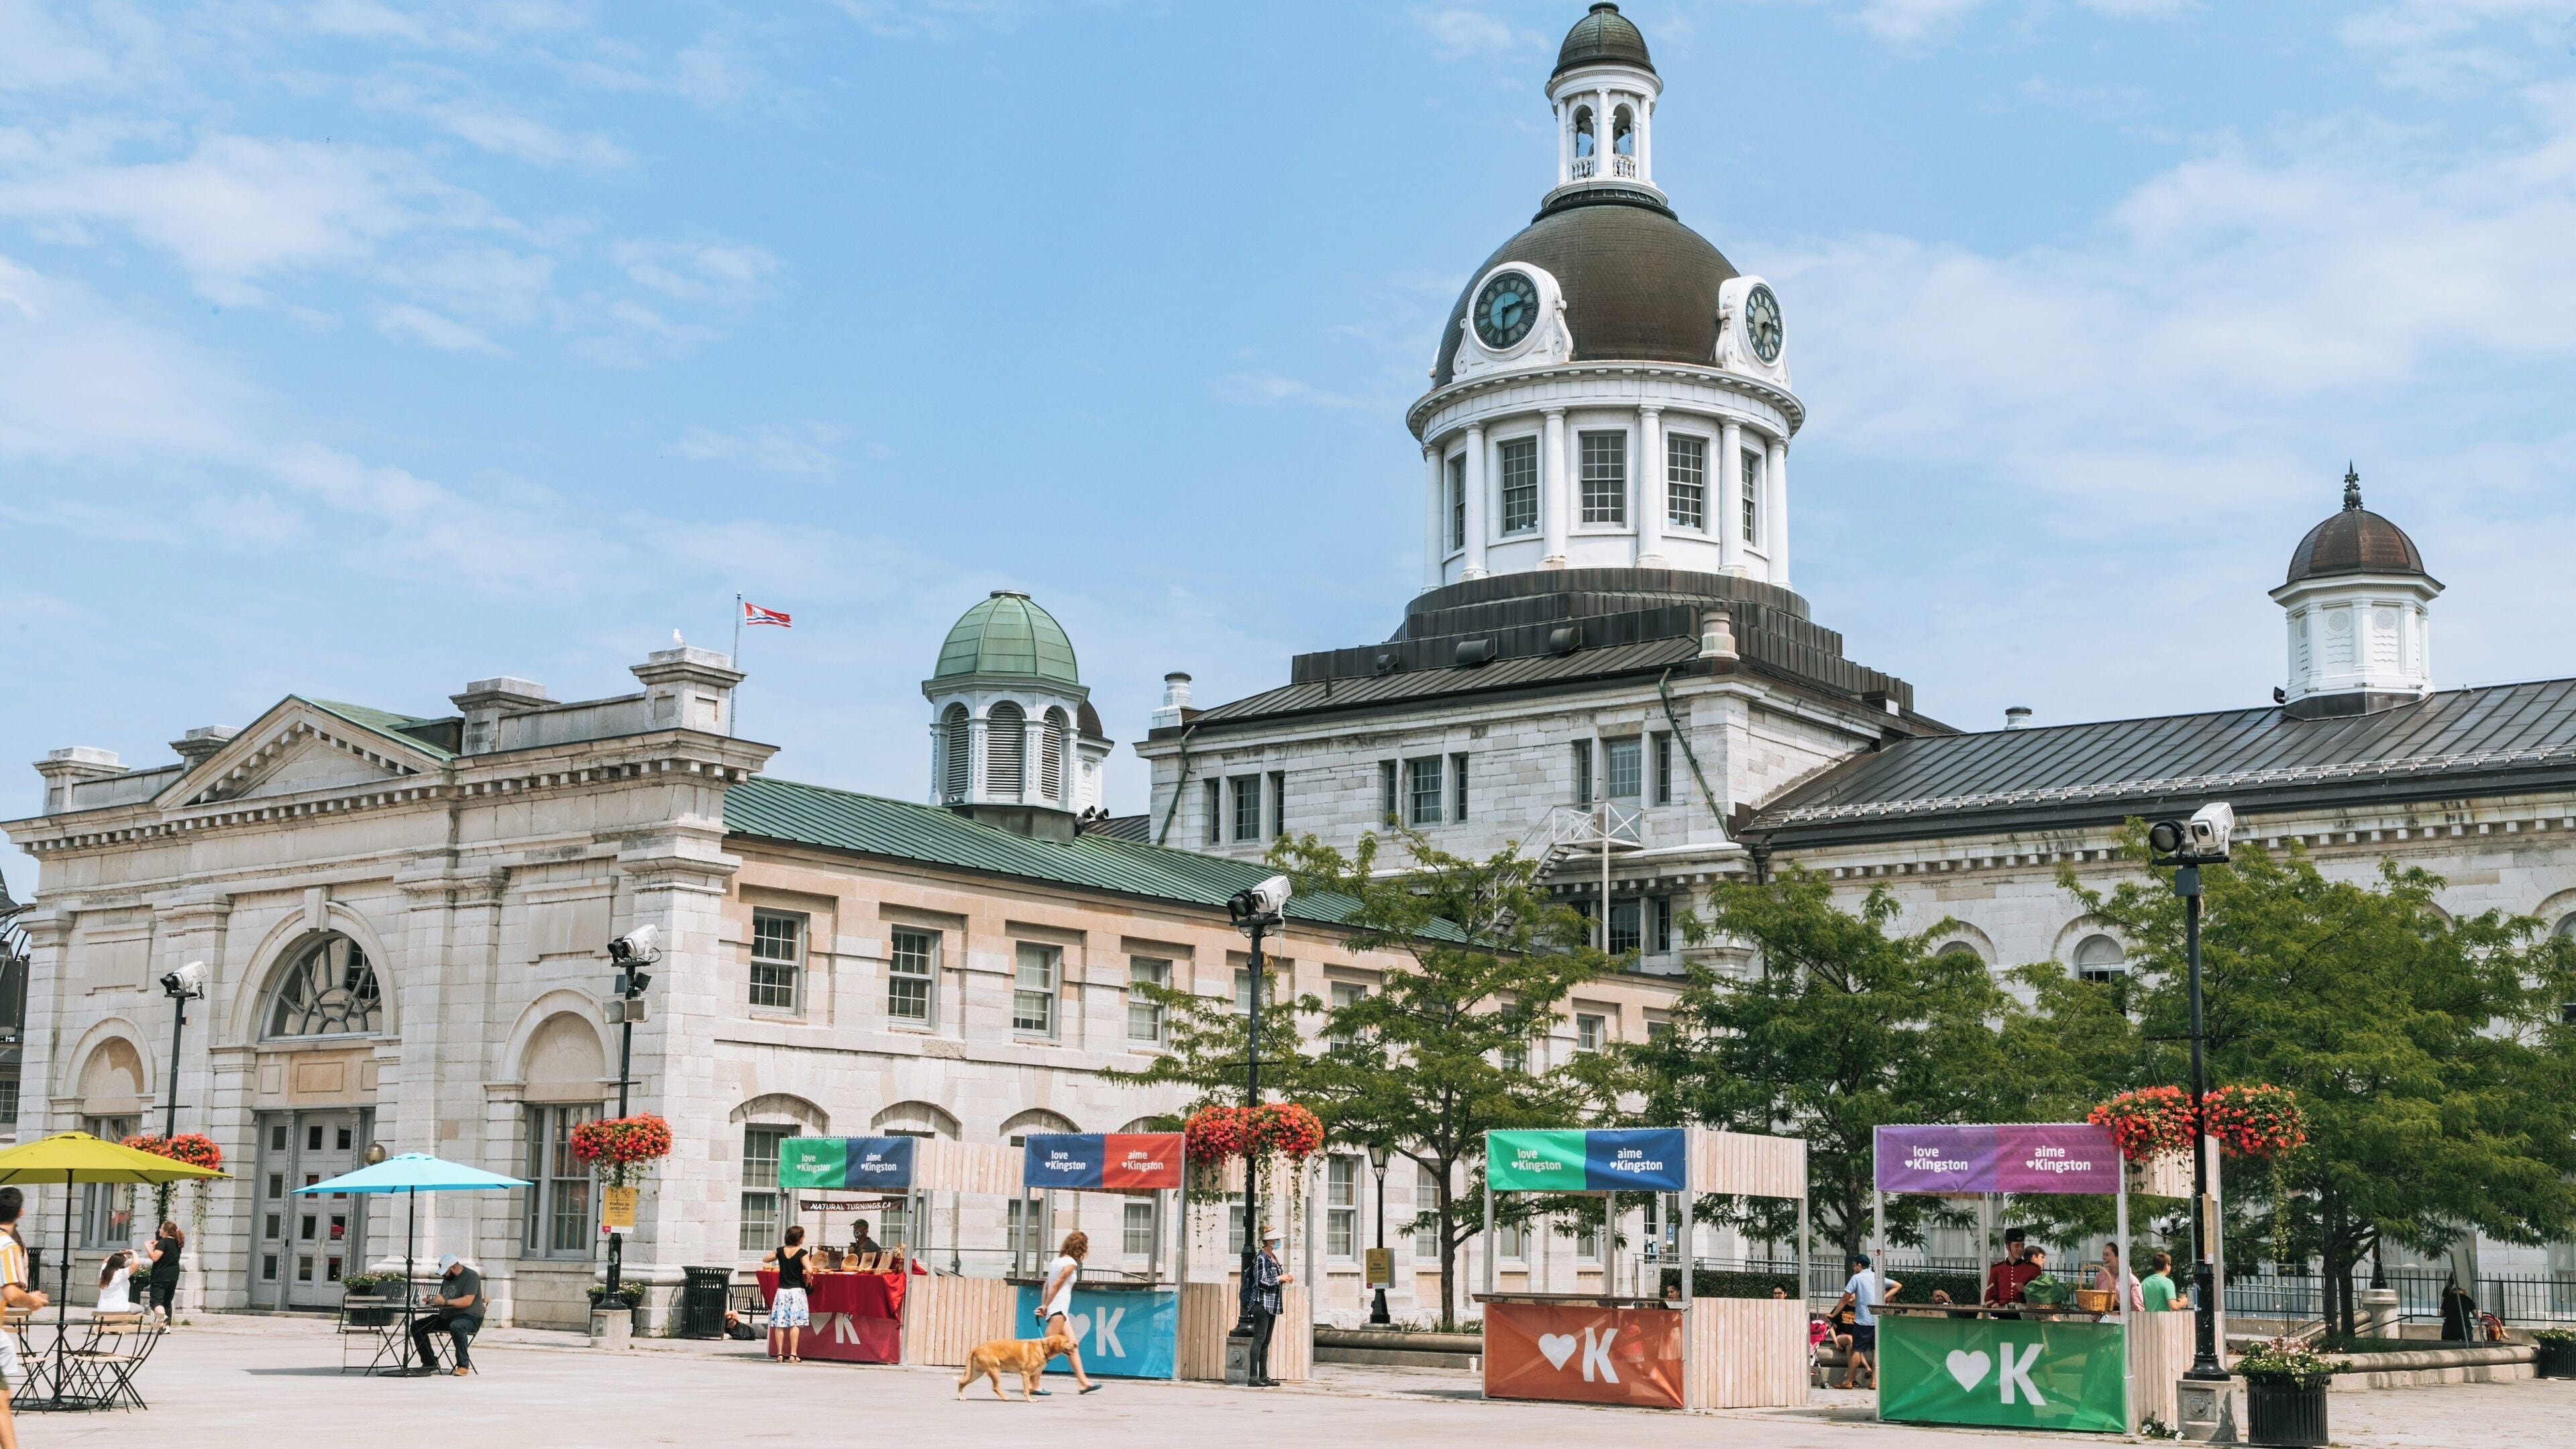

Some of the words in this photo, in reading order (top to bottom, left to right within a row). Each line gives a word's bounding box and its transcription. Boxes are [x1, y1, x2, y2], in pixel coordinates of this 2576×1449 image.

[865, 1152, 881, 1162] aime
[1051, 1150, 1069, 1160] love
[1127, 1150, 1148, 1160] aime
[1517, 1148, 1538, 1159] love
[1617, 1148, 1642, 1159] aime
[1913, 1145, 1939, 1157] love
[2035, 1145, 2065, 1157] aime
[802, 1153, 816, 1162] love
[801, 1162, 830, 1173] Kingston
[865, 1162, 897, 1173] Kingston
[1051, 1160, 1086, 1173] Kingston
[1127, 1160, 1164, 1173] Kingston
[1518, 1159, 1562, 1173] Kingston
[1616, 1159, 1663, 1173] Kingston
[1913, 1157, 1968, 1173] Kingston
[2035, 1158, 2091, 1174] Kingston
[810, 1202, 845, 1211] NATURAL
[835, 1312, 861, 1345] K
[1095, 1306, 1126, 1358] K
[1582, 1326, 1621, 1385] K
[1998, 1342, 2047, 1407] K
